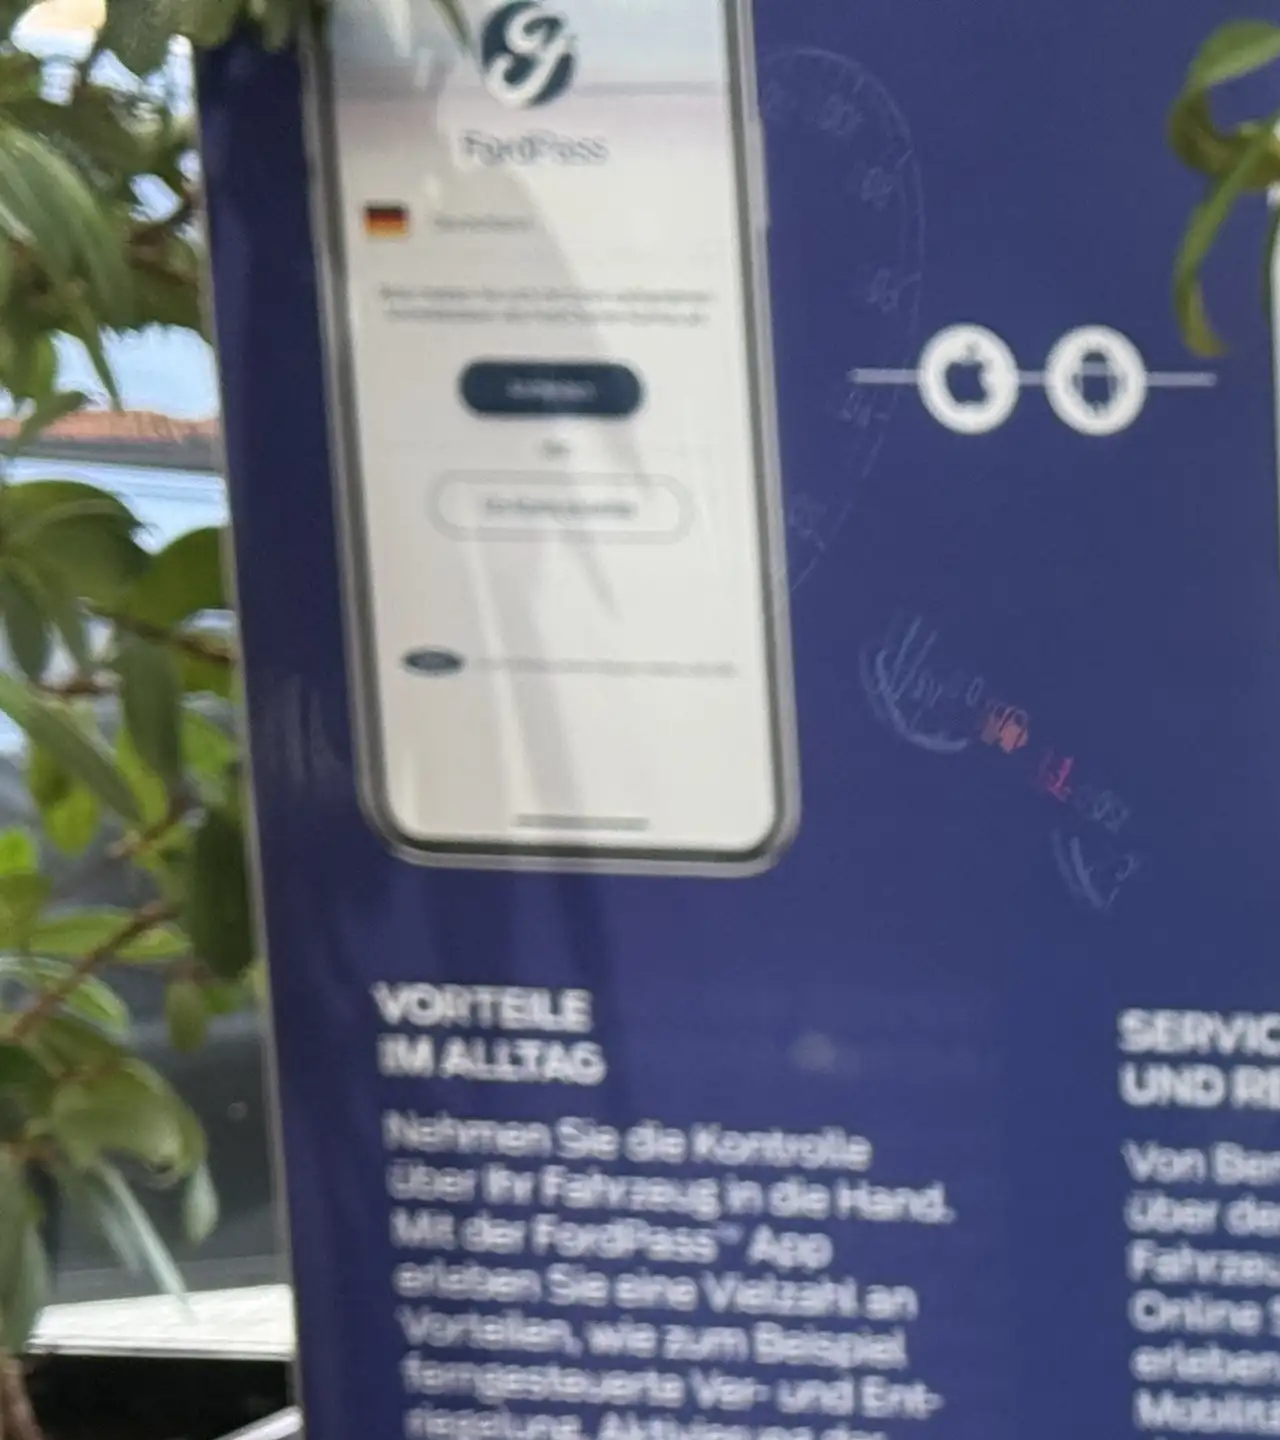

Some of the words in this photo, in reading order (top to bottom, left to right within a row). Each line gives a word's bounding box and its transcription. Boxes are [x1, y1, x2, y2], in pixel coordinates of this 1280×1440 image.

[373, 982, 592, 1035] VORTEILE
[379, 1034, 440, 1077] IM
[439, 1038, 606, 1085] ALLTAG
[1120, 1063, 1228, 1107] UND
[384, 1111, 554, 1157] Nehmen
[555, 1117, 621, 1160] Sie
[624, 1120, 689, 1163] die
[690, 1125, 872, 1171] Kontrolle
[1122, 1142, 1208, 1183] Von
[538, 1165, 722, 1219] Fahrzeug
[722, 1175, 766, 1214] in
[764, 1177, 831, 1219] die
[391, 1208, 457, 1250] Mit
[461, 1211, 528, 1254] der
[747, 1225, 833, 1271] App
[395, 1260, 544, 1302] erleben
[546, 1263, 611, 1306] Sie
[612, 1270, 698, 1311] eine
[701, 1270, 859, 1317] Vielzahl
[861, 1285, 918, 1319] an
[1129, 1290, 1264, 1336] Online
[663, 1325, 750, 1360] zum
[752, 1322, 907, 1369] Beispiel
[776, 1376, 856, 1415] und
